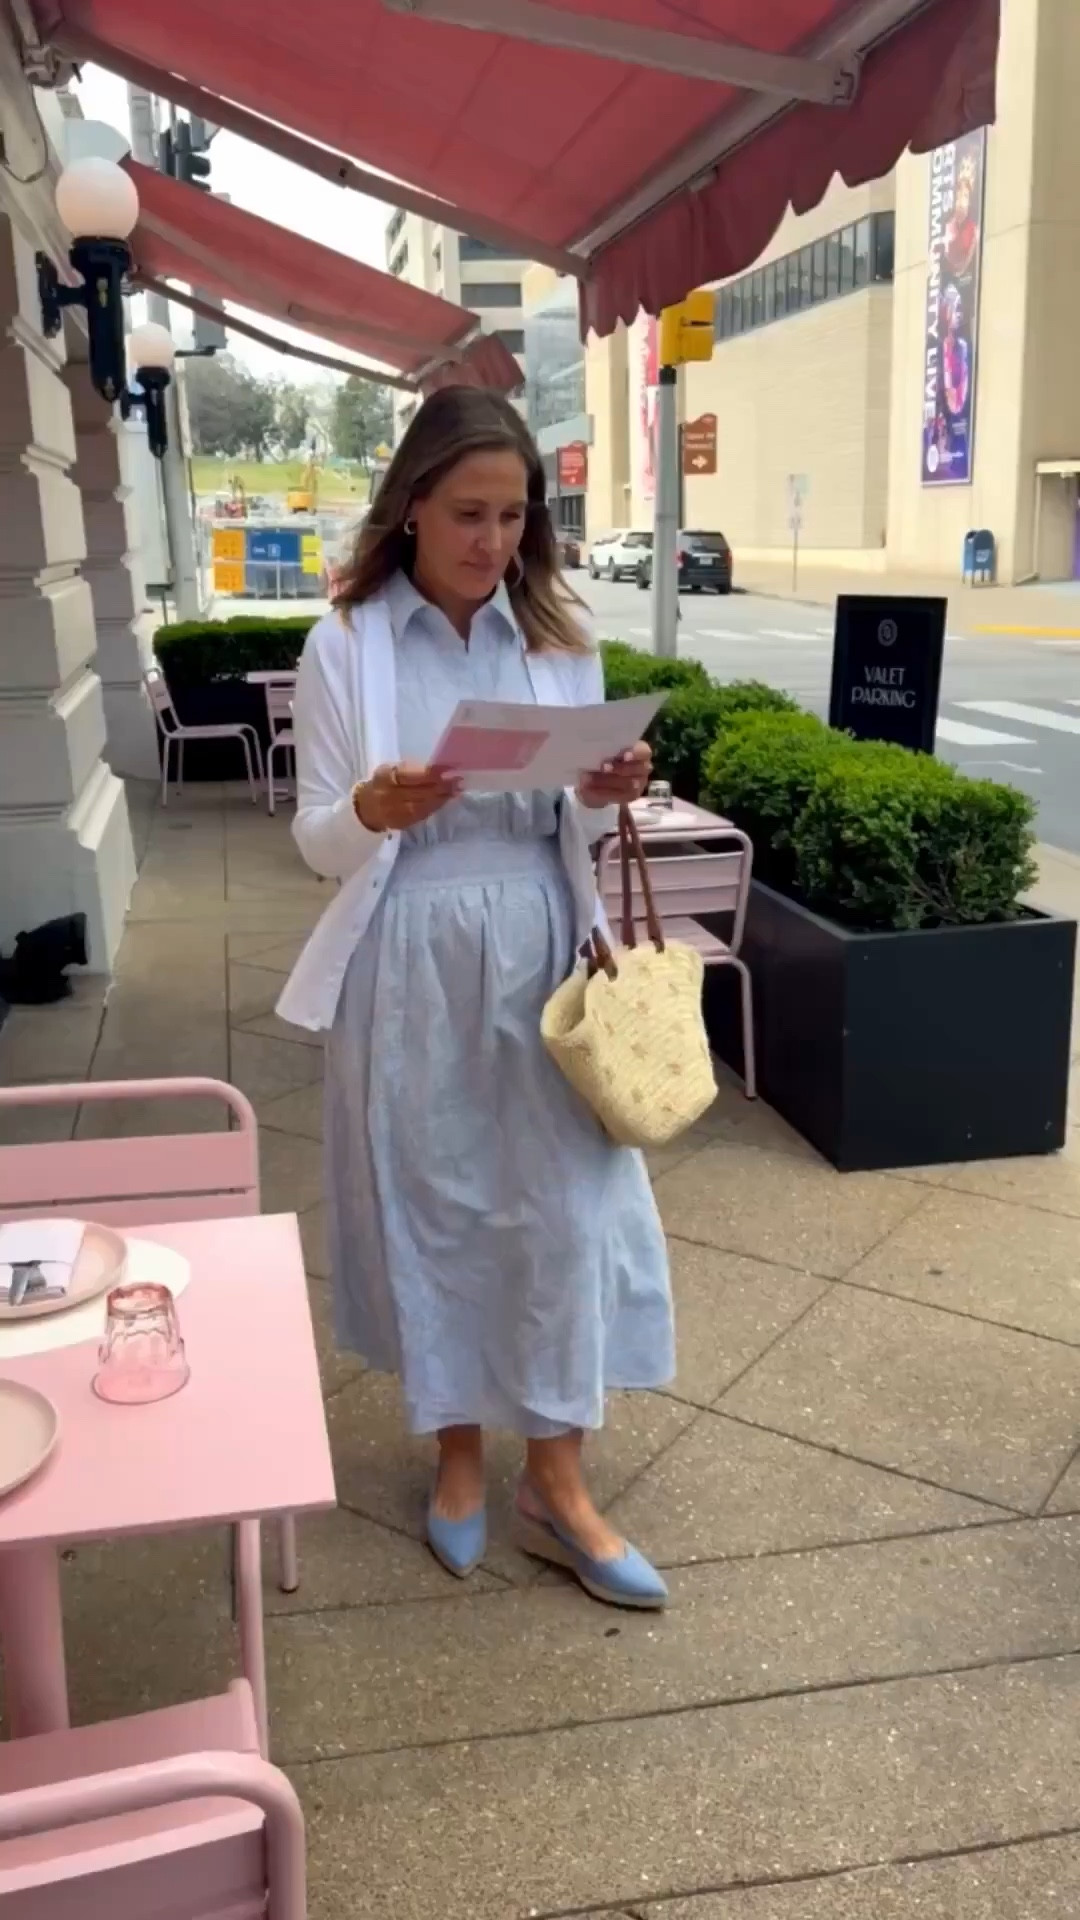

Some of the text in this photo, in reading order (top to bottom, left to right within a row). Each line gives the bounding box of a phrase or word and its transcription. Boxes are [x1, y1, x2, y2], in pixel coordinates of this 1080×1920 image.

[942, 143, 956, 212] RTS
[923, 147, 943, 420] OMMUNITY LIVE
[851, 686, 917, 708] PARKING
[864, 665, 906, 685] VALET
